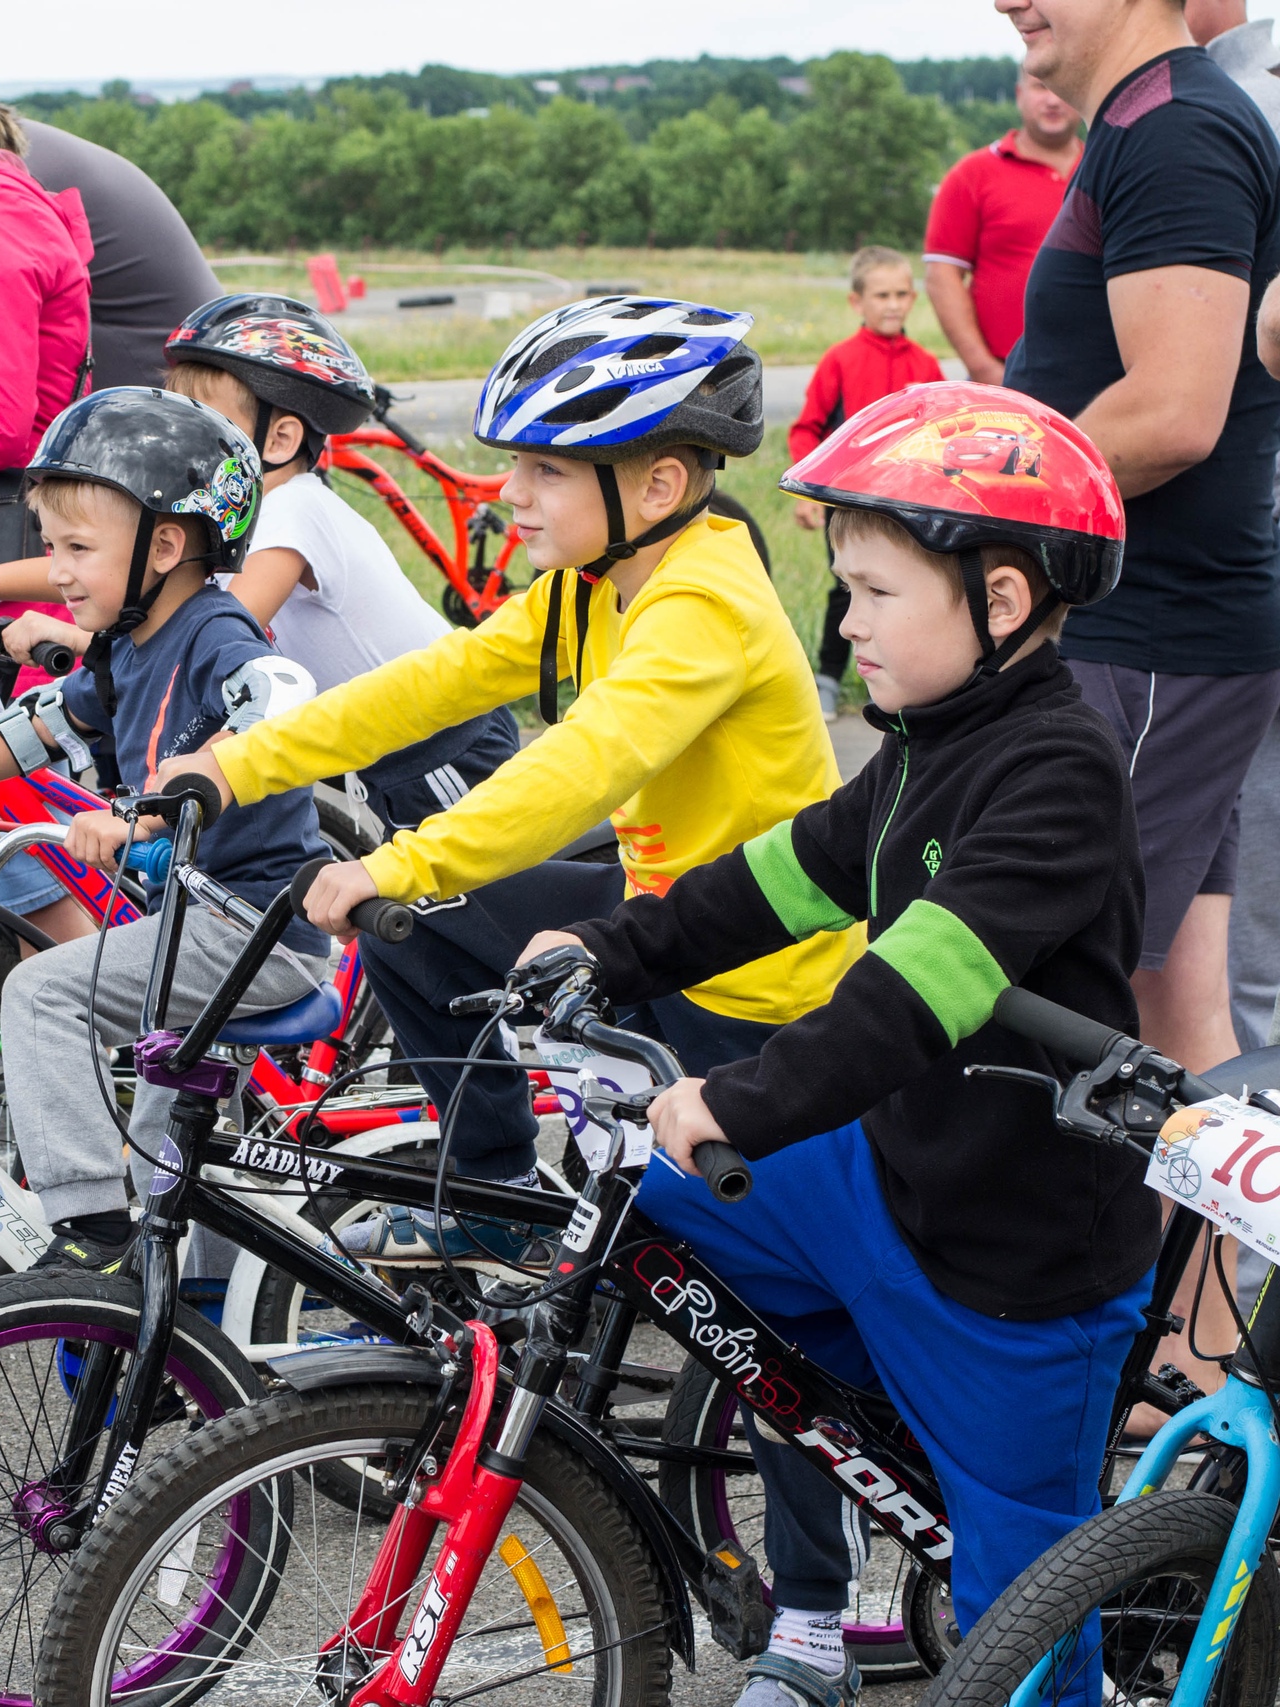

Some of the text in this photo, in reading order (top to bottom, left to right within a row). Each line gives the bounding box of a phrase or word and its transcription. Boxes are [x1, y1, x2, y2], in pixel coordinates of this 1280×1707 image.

[606, 361, 666, 380] VINCA
[665, 1279, 762, 1386] Robin
[399, 1571, 448, 1685] RST
